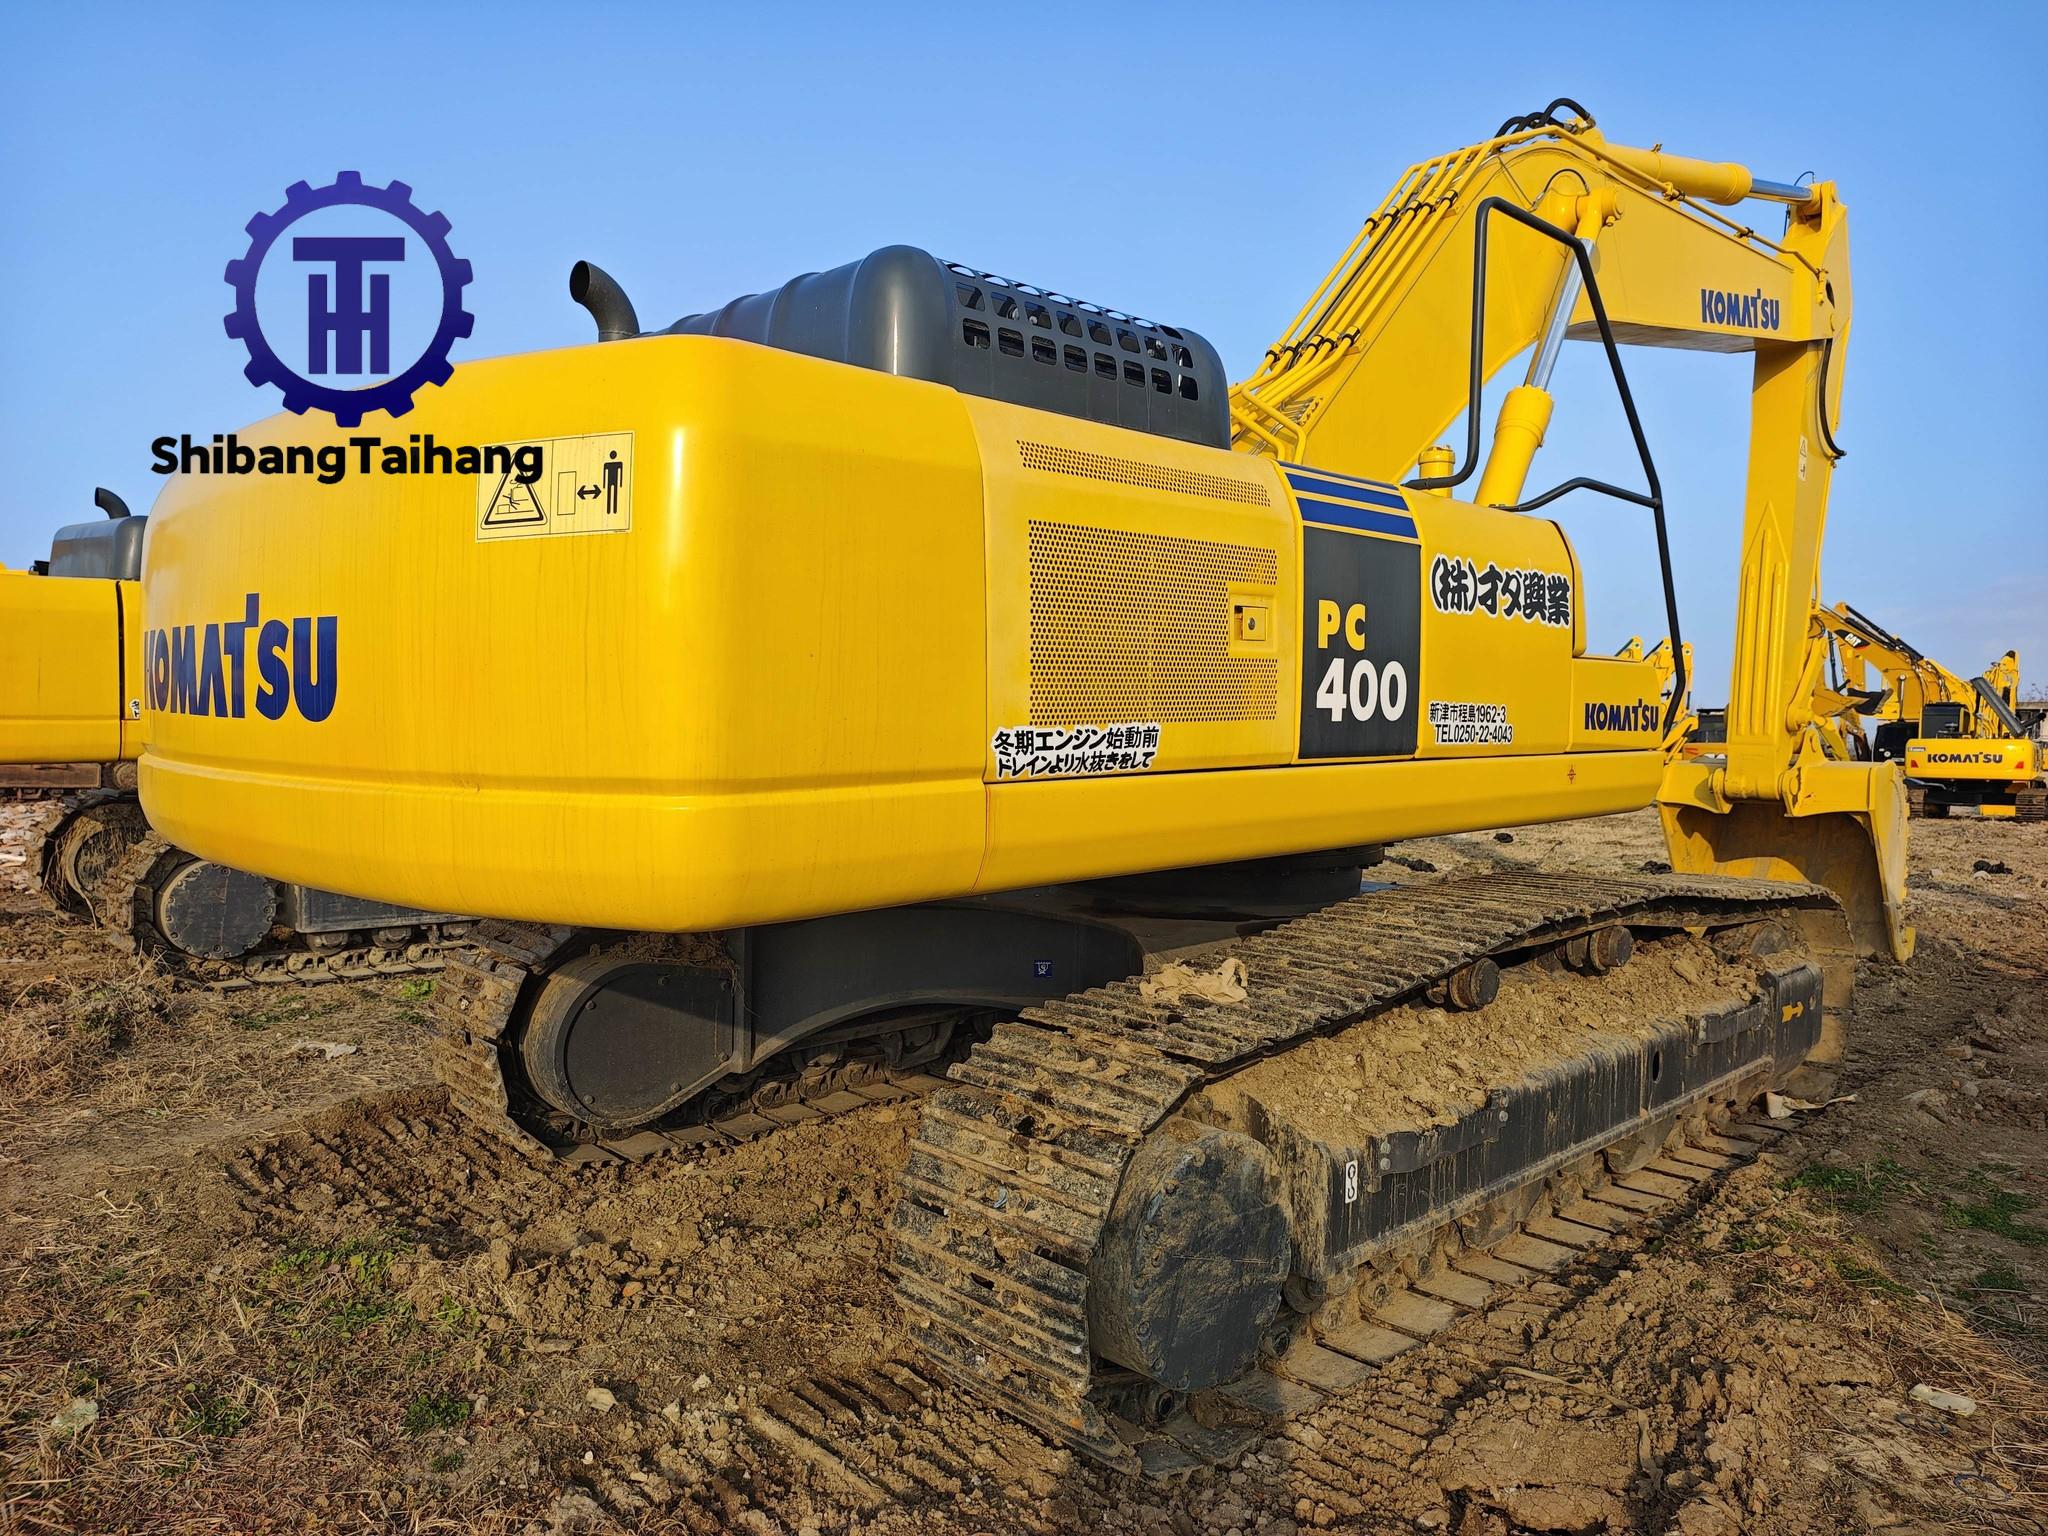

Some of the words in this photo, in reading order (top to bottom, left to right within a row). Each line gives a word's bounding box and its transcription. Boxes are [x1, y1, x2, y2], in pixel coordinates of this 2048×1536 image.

[1701, 288, 1779, 330] KOMATSU
[1318, 599, 1366, 651] PC
[144, 593, 338, 722] KOMATSU
[1316, 658, 1407, 721] 400
[1584, 698, 1659, 731] KOMATSU
[994, 726, 1160, 757] 冬期エンジン始動前
[1927, 752, 2003, 763] KOMATSU
[999, 751, 1155, 777] ドレインより水抜きをして
